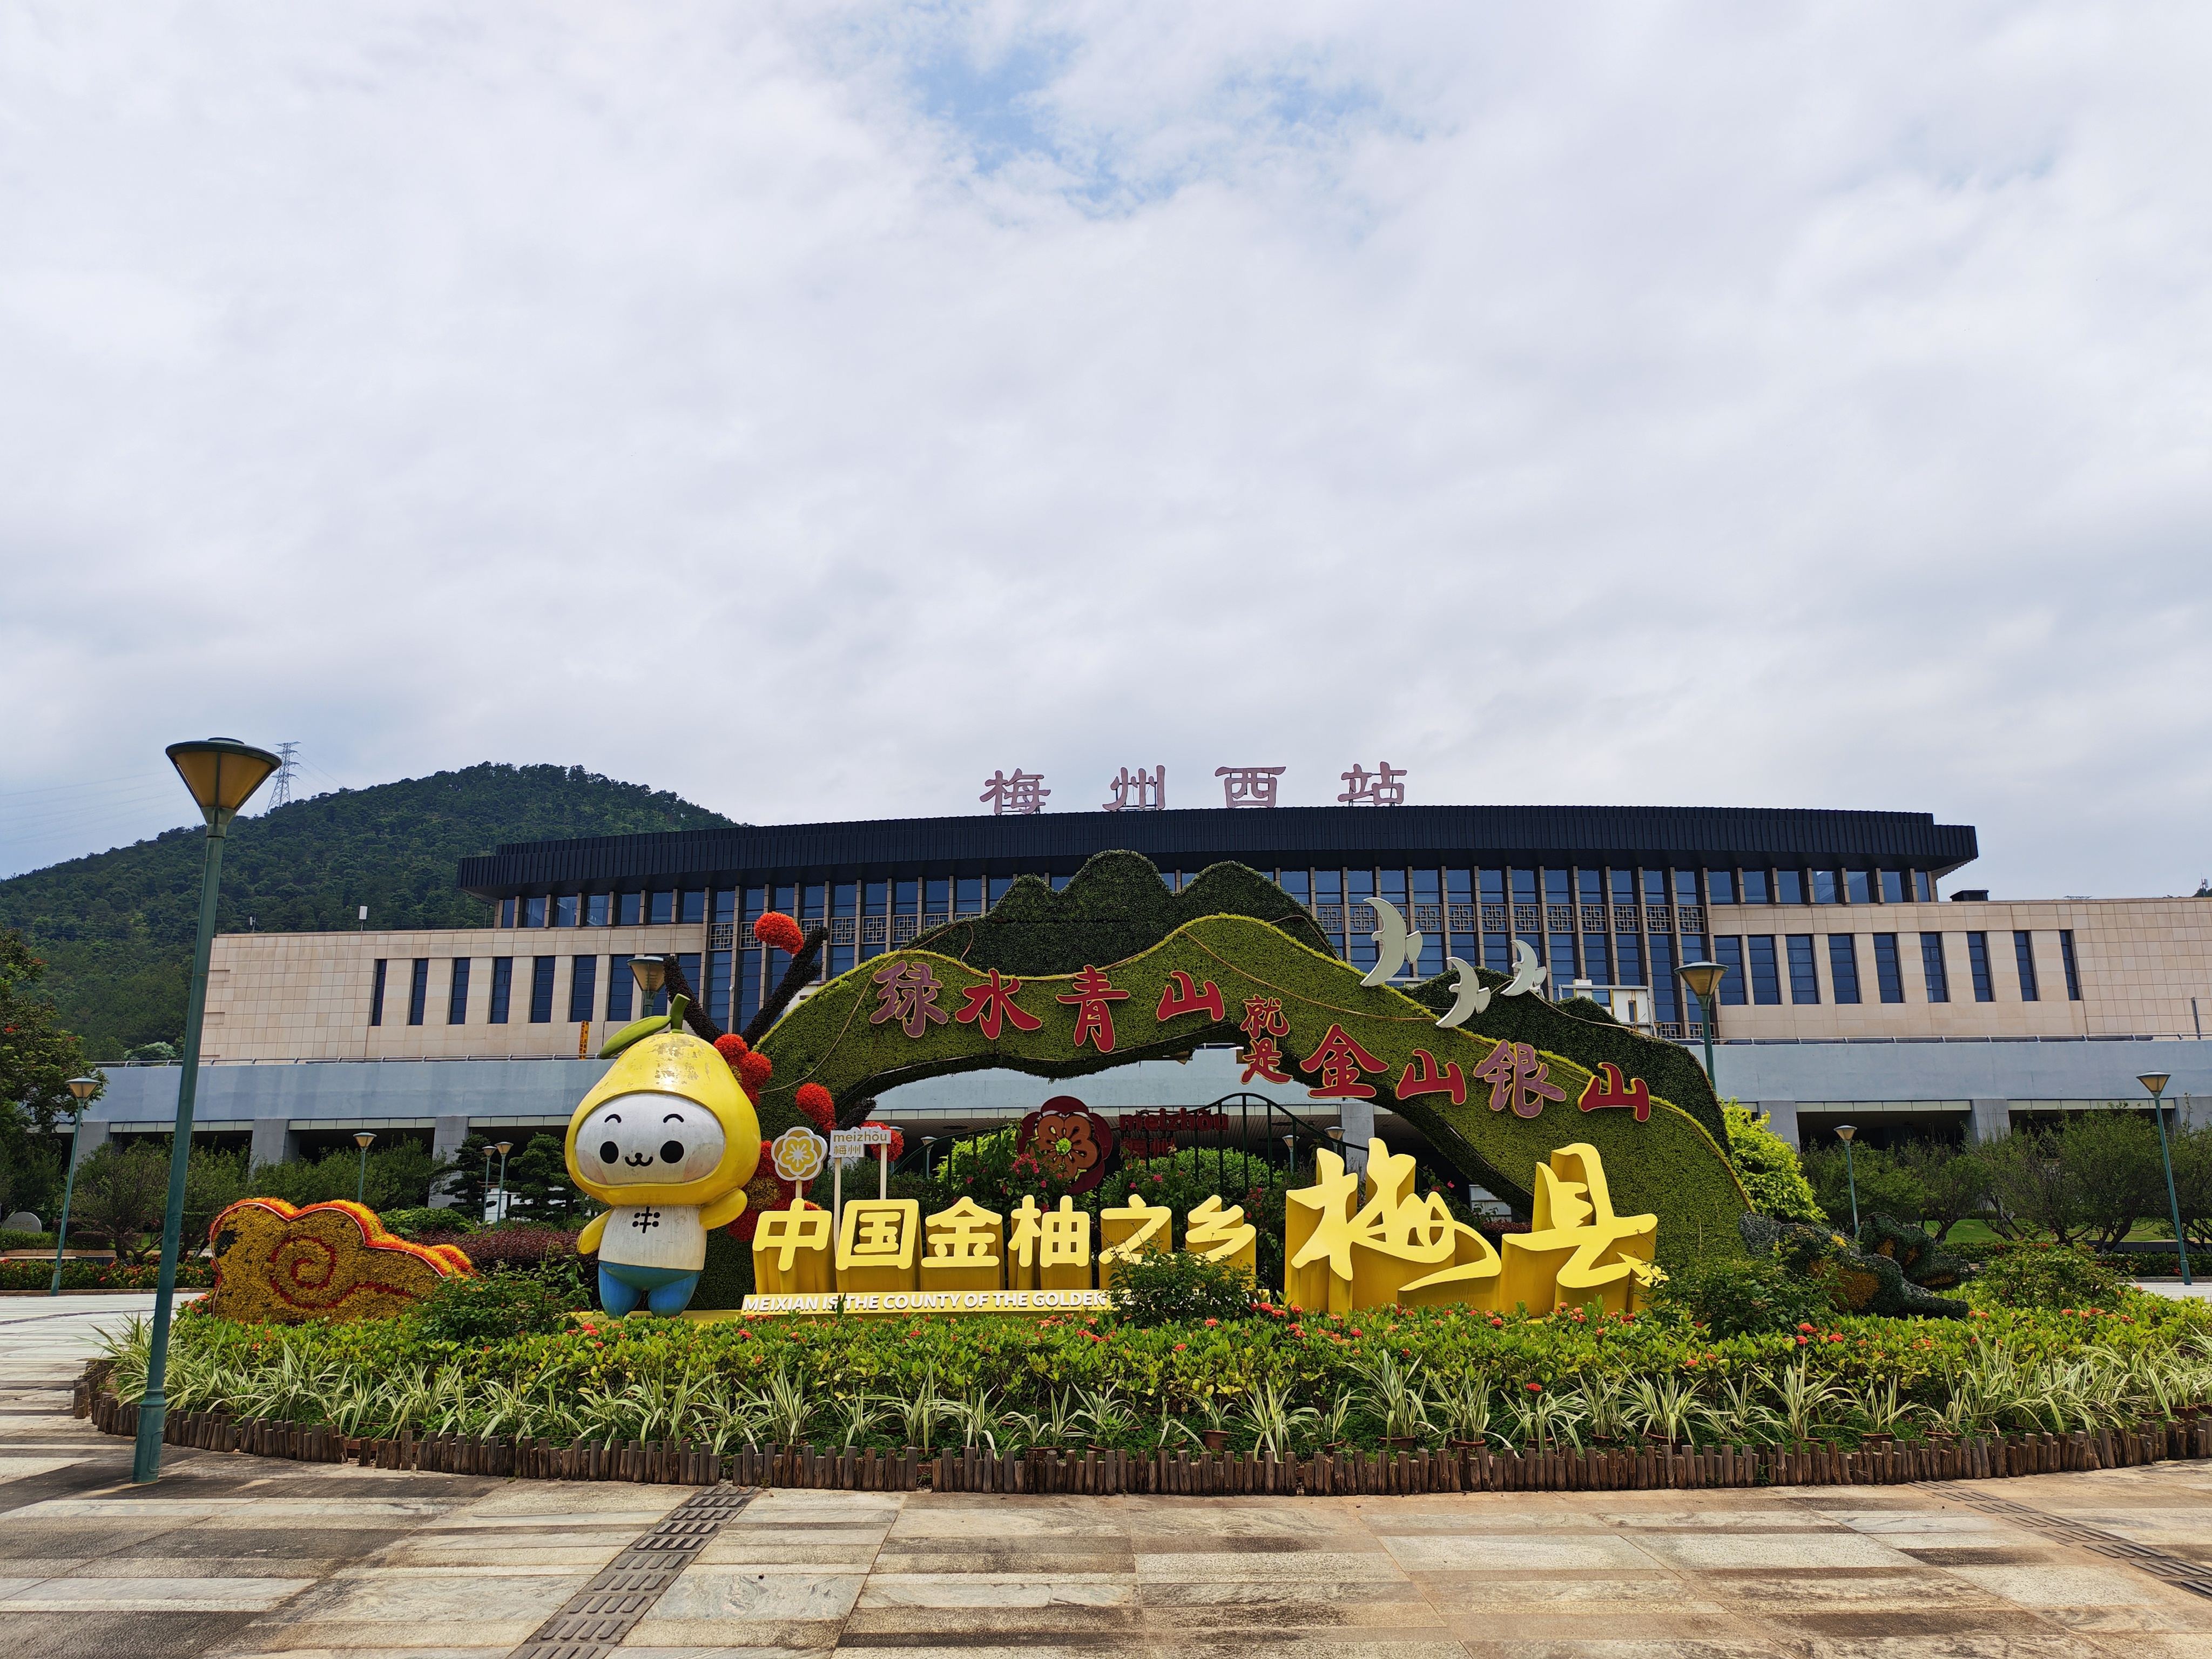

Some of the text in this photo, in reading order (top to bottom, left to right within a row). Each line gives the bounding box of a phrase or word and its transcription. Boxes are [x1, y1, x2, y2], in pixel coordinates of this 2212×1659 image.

[980, 762, 1407, 814] 梅州西站
[869, 960, 1225, 1053] 绿水青山
[1240, 994, 1293, 1085] 就是
[1300, 1023, 1651, 1123] 金山银山
[834, 1144, 861, 1155] 梅州
[752, 1194, 1257, 1272] 中国金柚之乡
[1285, 1137, 1669, 1291] 梅县
[743, 1297, 818, 1311] MEIXIAN
[822, 1296, 839, 1311] IS
[845, 1295, 879, 1310] THE
[882, 1293, 960, 1309] COUNTY
[964, 1292, 989, 1308] OF
[993, 1292, 1029, 1307] THE
[1032, 1291, 1107, 1307] GOLDEN
